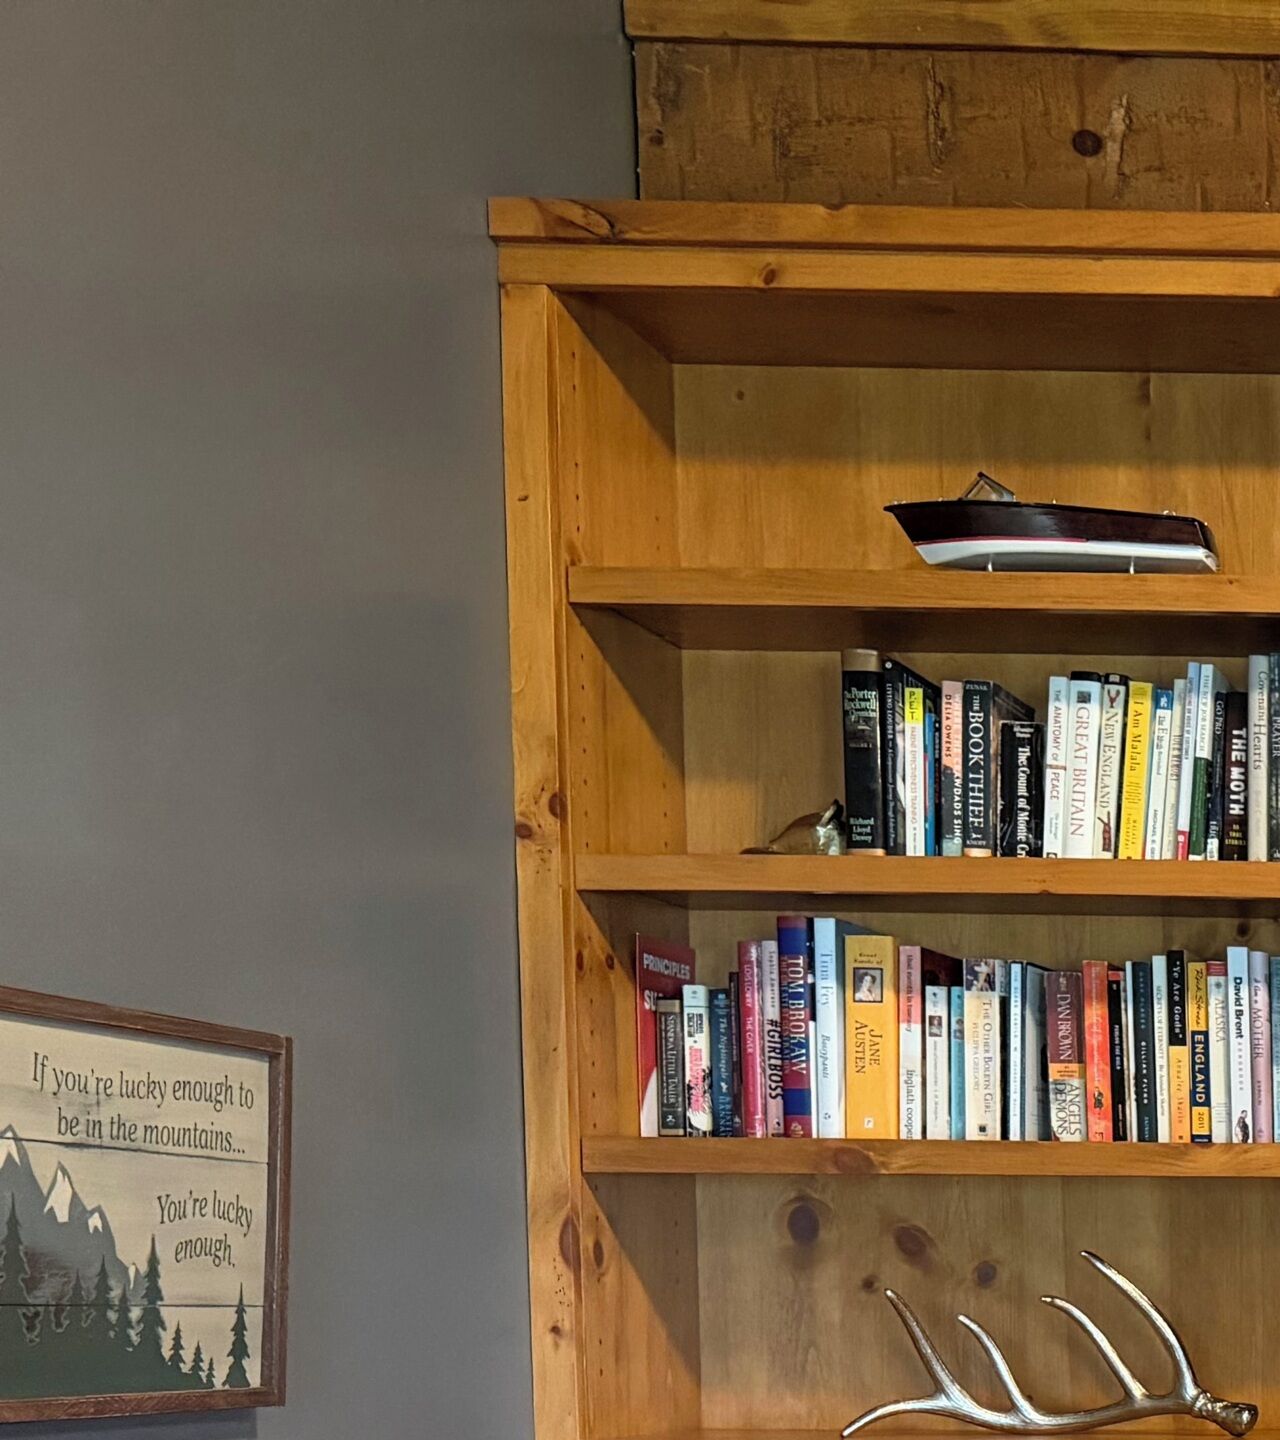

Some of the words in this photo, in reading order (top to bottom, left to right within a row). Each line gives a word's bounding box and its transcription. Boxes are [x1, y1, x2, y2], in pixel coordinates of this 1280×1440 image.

[944, 694, 952, 721] DELIA
[1257, 670, 1268, 722] Covenant
[969, 711, 984, 766] BOOK
[1052, 706, 1062, 750] ANATOMY
[1074, 706, 1090, 764] GREAT
[1104, 710, 1119, 742] NEW
[1133, 710, 1144, 728] Am
[1271, 716, 1280, 758] PRAYER
[944, 724, 952, 758] OWENS
[1018, 745, 1031, 766] The
[1129, 733, 1142, 772] Malala
[1230, 728, 1246, 762] THE
[1253, 723, 1266, 770] Hearts
[1017, 767, 1030, 796] Count
[1050, 772, 1060, 800] PEACE
[1099, 744, 1119, 808] ENGLAND
[1229, 766, 1245, 815] MOTH
[969, 769, 983, 827] THIEF
[1070, 767, 1087, 837] BRITAIN
[954, 819, 962, 844] SING
[1017, 810, 1030, 841] Monte
[788, 955, 804, 993] TOM
[1233, 977, 1243, 1007] David
[1056, 994, 1071, 1019] DAN
[1235, 1009, 1244, 1039] Brent
[788, 1000, 806, 1074] BROKAW
[820, 1034, 830, 1079] Bossypants
[855, 1020, 866, 1074] AUSTEN
[869, 1029, 883, 1066] JANE
[1057, 1021, 1073, 1061] BROWN
[767, 1019, 784, 1100] #GIRLBOSS
[1194, 1034, 1208, 1103] ENGLAND
[33, 1052, 49, 1092] If
[52, 1065, 114, 1097] you're
[119, 1070, 166, 1108] lucky
[172, 1074, 233, 1113] enough
[239, 1082, 254, 1109] to
[57, 1107, 80, 1137] be
[85, 1112, 103, 1139] in
[109, 1113, 138, 1142] the
[144, 1121, 246, 1154] mountains...
[1054, 1082, 1068, 1136] DEMONS
[1067, 1082, 1082, 1136] ANGELS
[157, 1190, 207, 1224] You're
[212, 1190, 253, 1237] lucky
[175, 1234, 235, 1268] enough.
